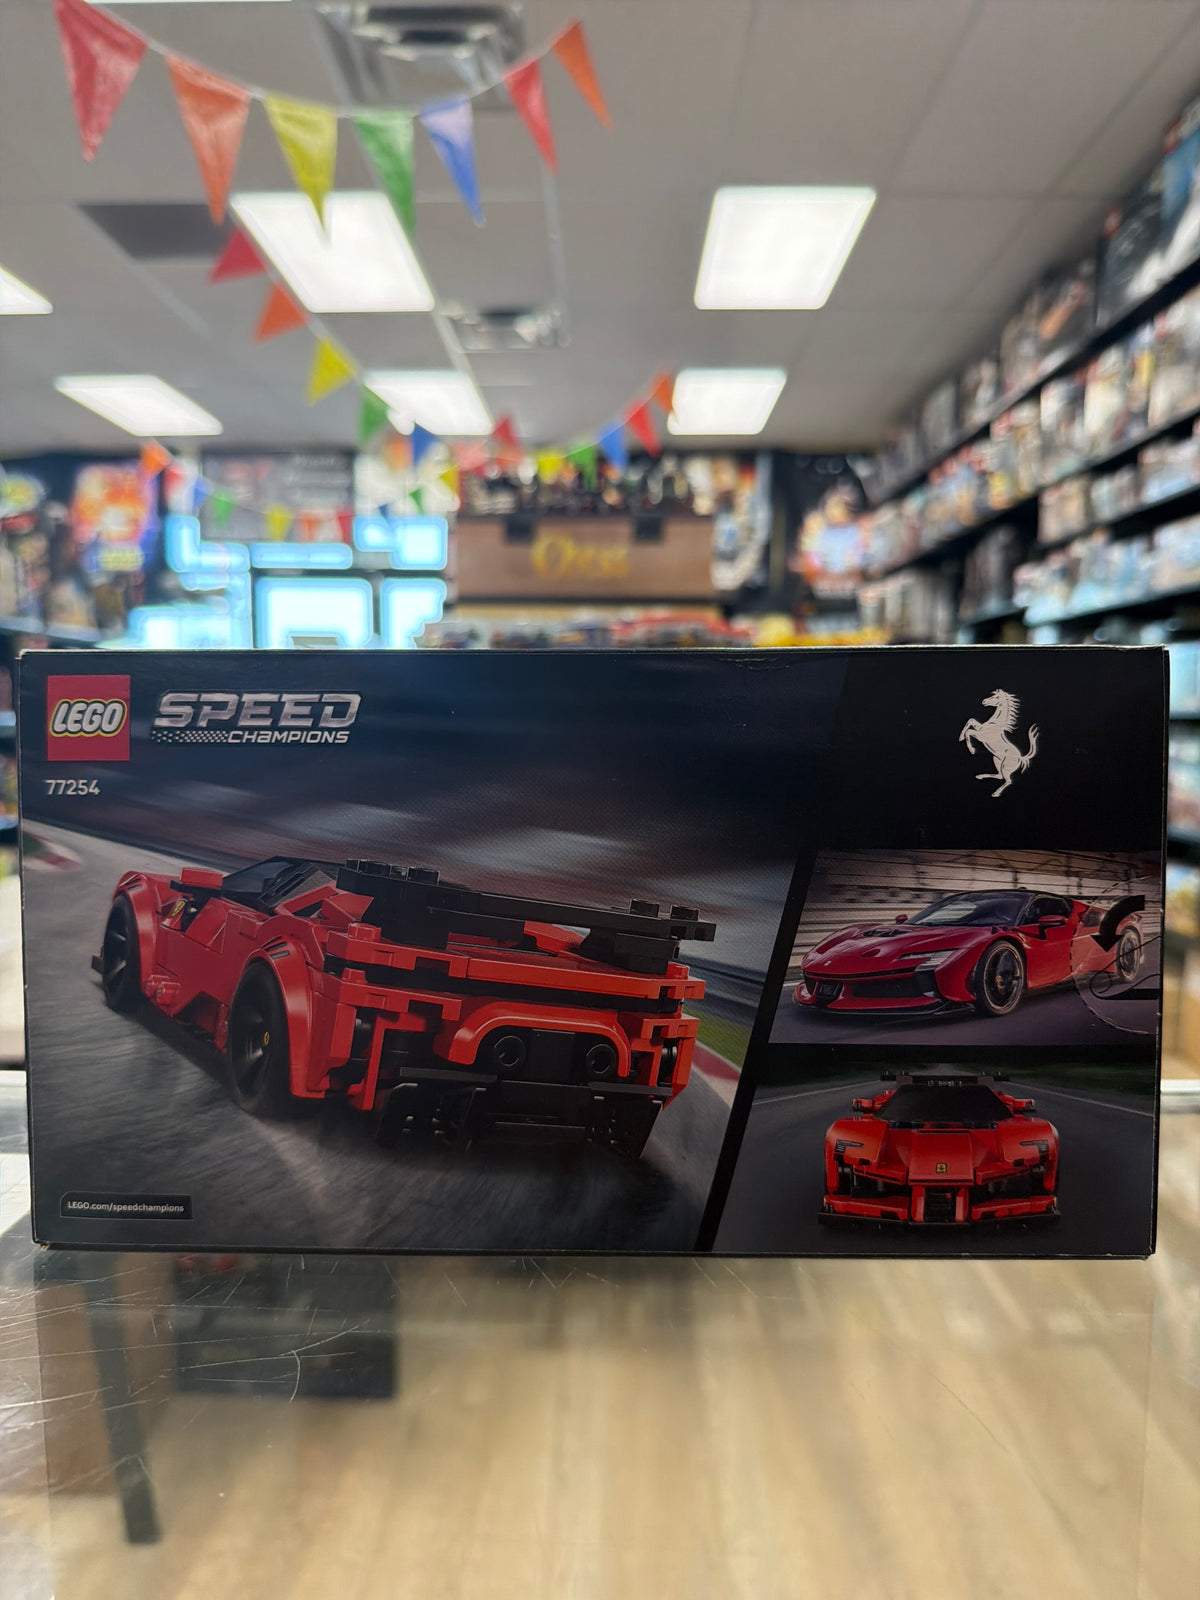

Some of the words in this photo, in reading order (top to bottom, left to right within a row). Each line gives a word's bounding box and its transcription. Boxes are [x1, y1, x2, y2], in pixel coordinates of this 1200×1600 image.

[153, 691, 362, 728] SPEED
[52, 700, 126, 737] LEGO
[227, 730, 350, 744] CHAMPIONS
[45, 779, 101, 796] 77254
[67, 1200, 185, 1213] LEGO.com/speedchampions
